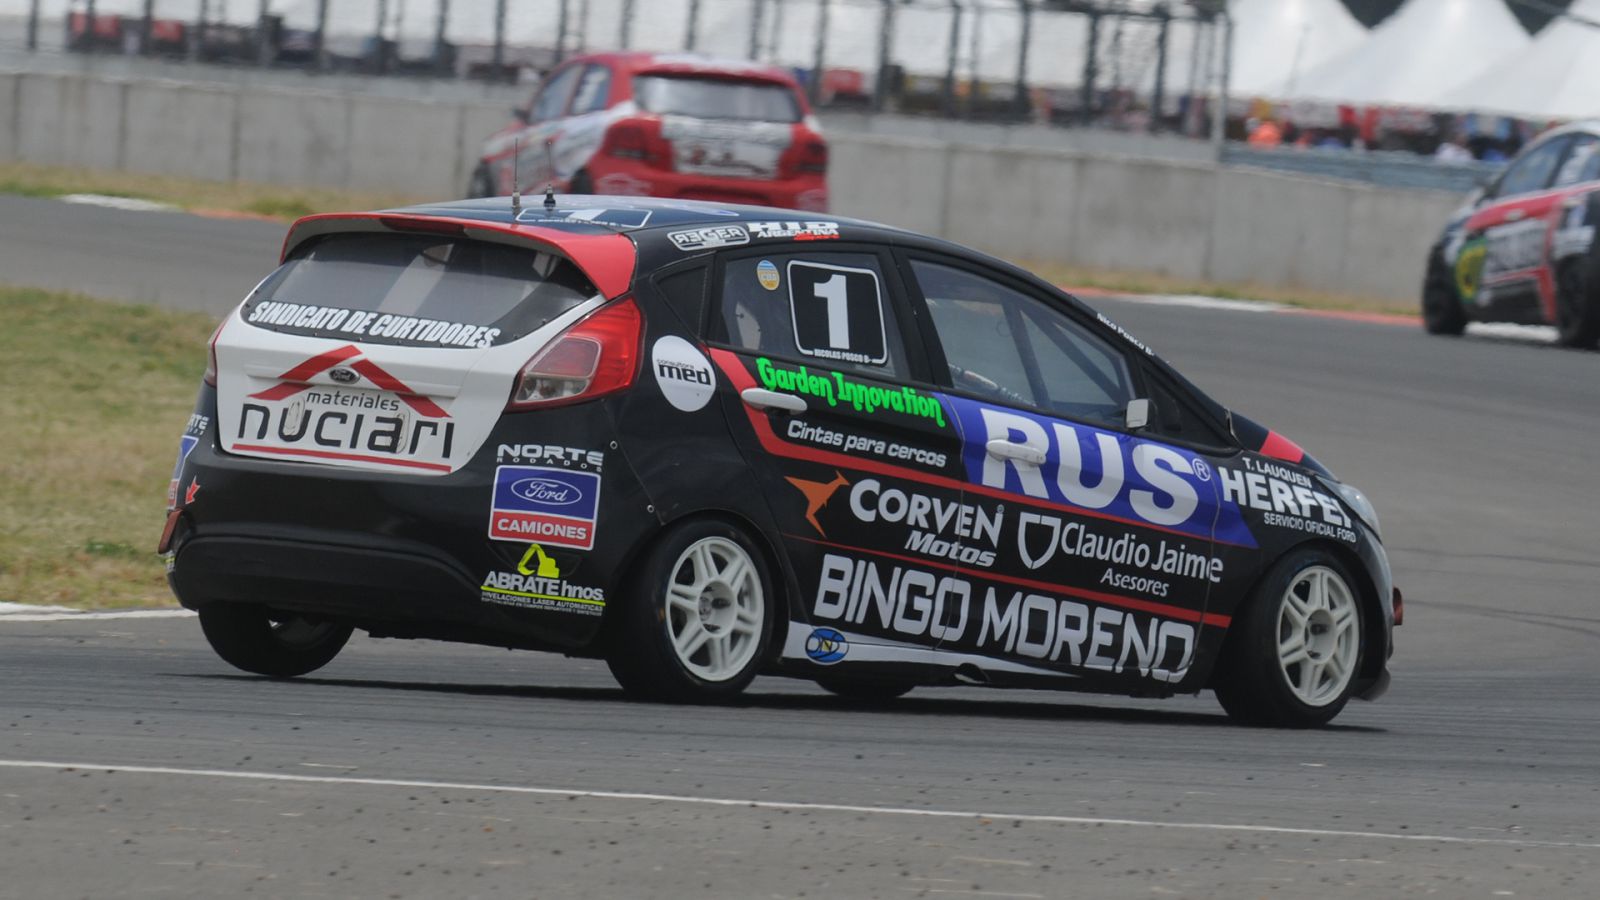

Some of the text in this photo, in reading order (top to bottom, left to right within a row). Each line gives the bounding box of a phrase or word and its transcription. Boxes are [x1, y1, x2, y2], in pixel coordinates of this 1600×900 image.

[249, 301, 501, 348] SINDICATO DE CURTIDORES
[813, 274, 850, 350] 1
[658, 364, 711, 386] med
[306, 391, 400, 411] materiales
[756, 357, 946, 427] Garden Innovation
[238, 403, 455, 458] nuciari
[787, 420, 947, 467] Cintas para cercos
[497, 444, 603, 466] NORTE
[497, 457, 602, 472] RODADOS
[1242, 457, 1312, 488] T. LAUQUEN
[525, 481, 568, 501] Ford
[498, 518, 586, 539] CAMIONES
[850, 478, 1004, 548] CORVEN
[1264, 512, 1357, 543] SERVICIO OFICIAL FORD
[904, 530, 997, 567] Motos
[1061, 521, 1223, 582] Claudio Jaime
[483, 571, 560, 596] ABRATE
[1100, 568, 1169, 597] Asesores
[813, 553, 1196, 683] BINGO MORENO
